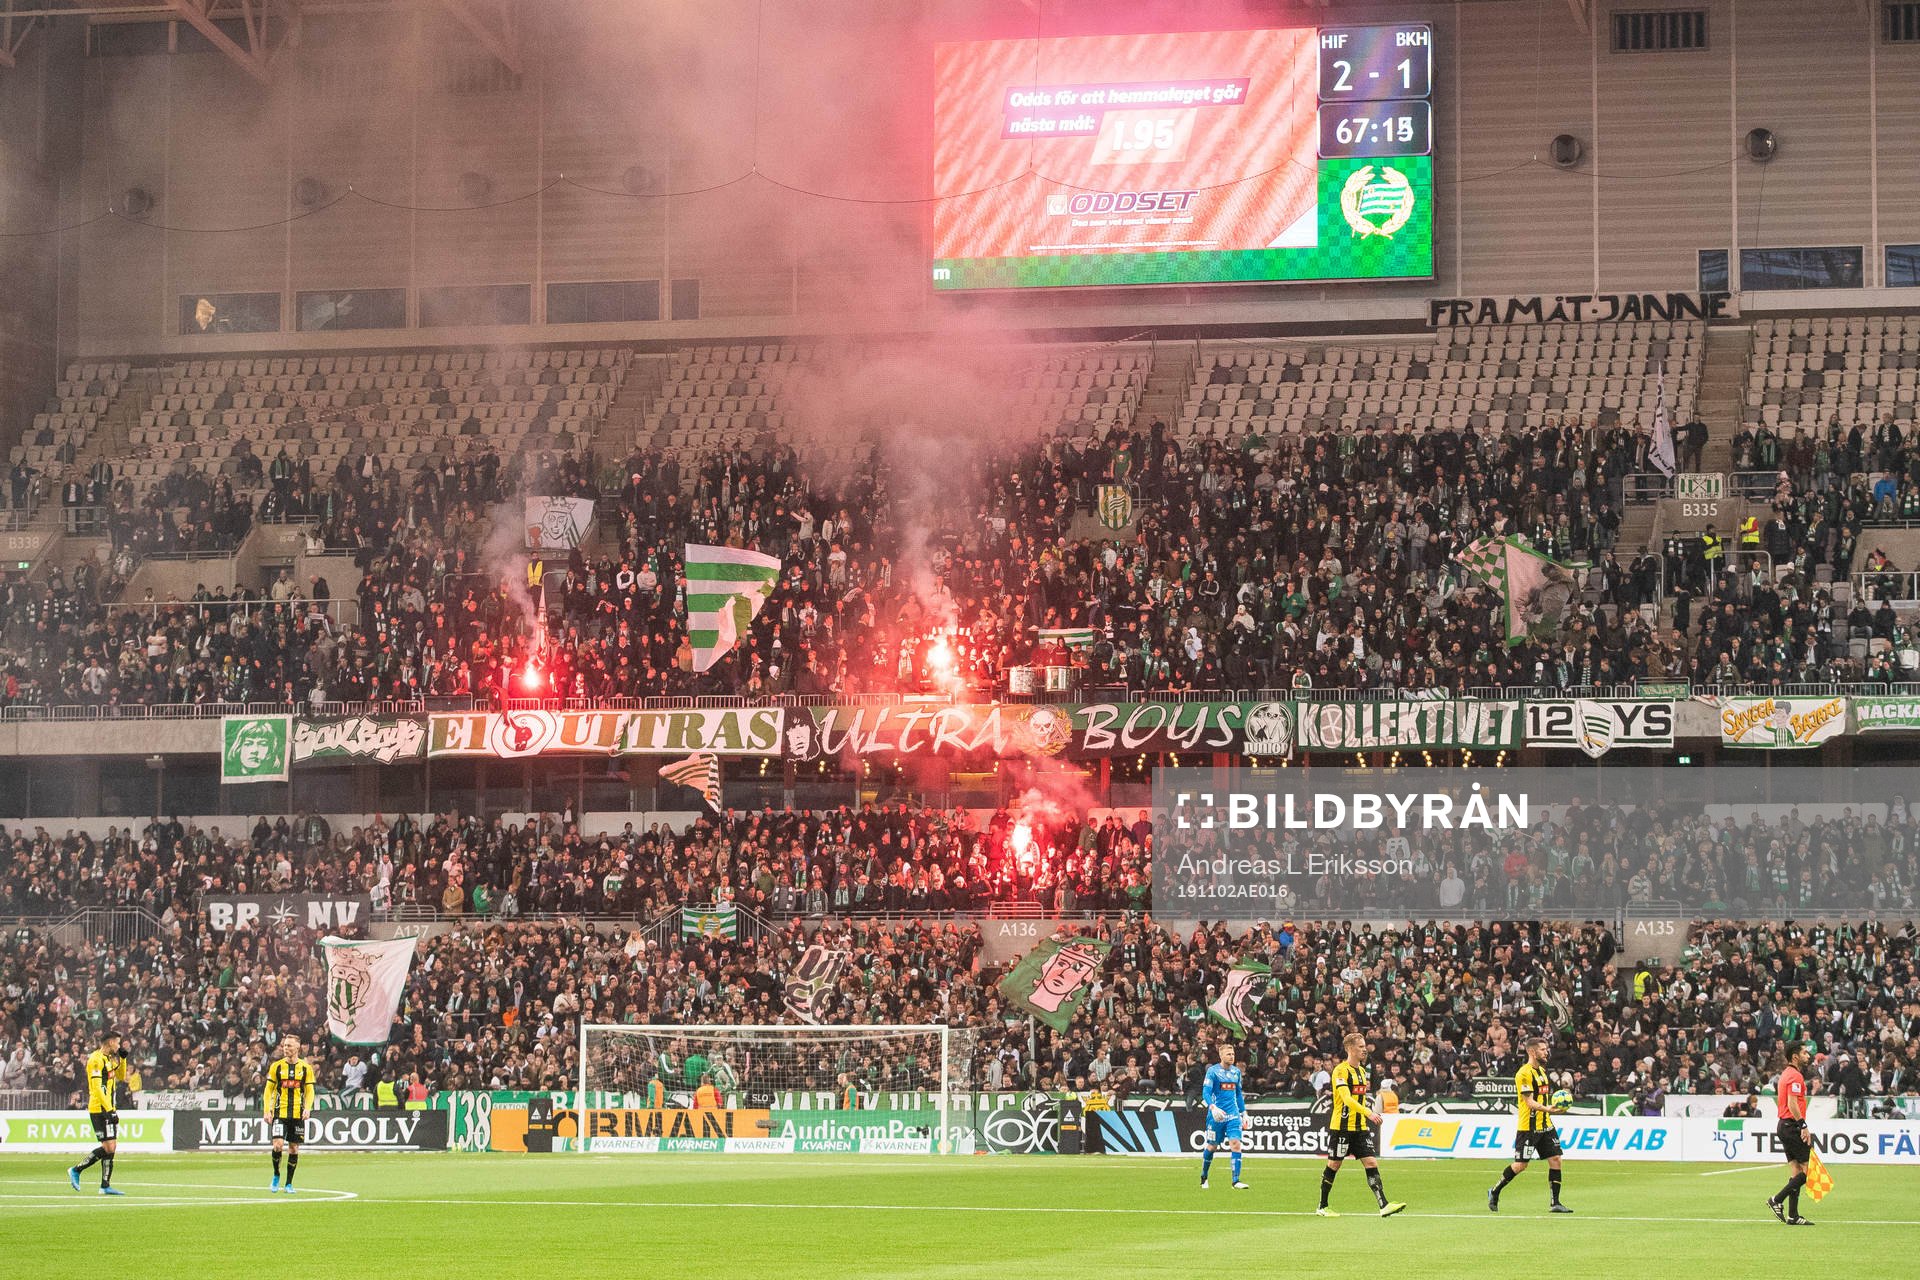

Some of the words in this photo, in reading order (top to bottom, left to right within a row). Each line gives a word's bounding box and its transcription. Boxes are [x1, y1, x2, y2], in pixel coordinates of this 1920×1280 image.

[1321, 34, 1348, 49] HIF
[1395, 31, 1428, 47] BKH
[1333, 60, 1353, 91] 2
[1397, 58, 1410, 89] 1
[1010, 92, 1051, 107] Odds
[1055, 90, 1079, 105] för
[1081, 91, 1105, 104] att
[1107, 86, 1211, 104] hemmalaget
[1213, 84, 1242, 103] gör
[1010, 118, 1056, 133] nästa
[1059, 114, 1095, 131] mål:
[1111, 118, 1175, 151] 1.95
[1070, 190, 1200, 214] ODDSET
[1683, 503, 1718, 516] B335
[1075, 704, 1241, 751] BOYS
[1299, 700, 1519, 749] KOLLEKTIVET
[1529, 706, 1572, 737] 12
[393, 925, 429, 939] A137
[999, 923, 1037, 937] A136
[1635, 921, 1675, 935] A135
[752, 1094, 769, 1102] SLO
[446, 1090, 492, 1149] 138
[1418, 1127, 1432, 1136] EL
[1469, 1126, 1503, 1149] EL
[1624, 1128, 1667, 1150] AB
[594, 1140, 645, 1149] KVARNEN
[667, 1140, 718, 1150] KVARNEN
[734, 1140, 785, 1150] KVARNEN
[875, 1141, 927, 1151] KVARNEN
[1878, 1129, 1920, 1155] FÄ
